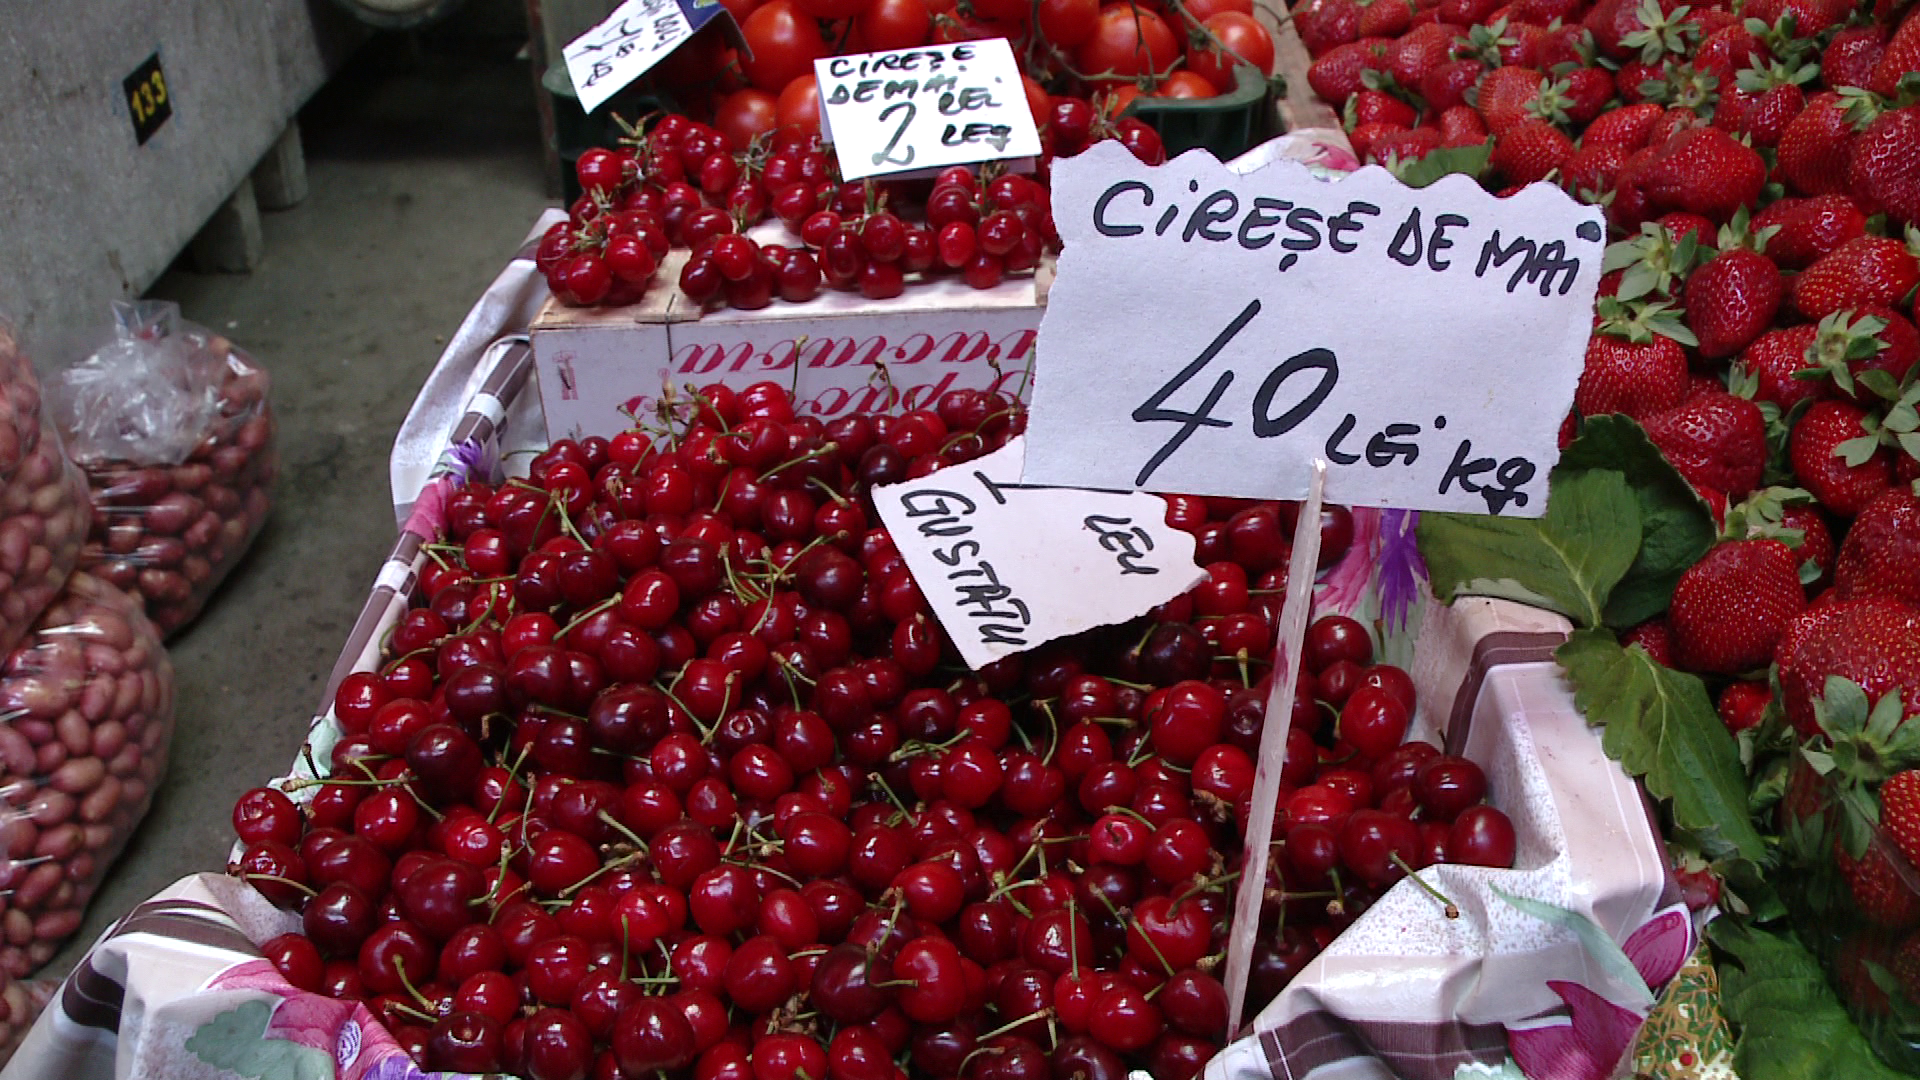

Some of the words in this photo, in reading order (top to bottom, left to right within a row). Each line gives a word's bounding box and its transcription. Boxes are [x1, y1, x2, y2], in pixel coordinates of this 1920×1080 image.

[132, 70, 167, 123] 133
[871, 101, 917, 166] 2
[1387, 207, 1470, 272] DE
[1132, 299, 1339, 487] 40
[900, 489, 1032, 646] GUSTATU
[1083, 515, 1159, 576] LEU
